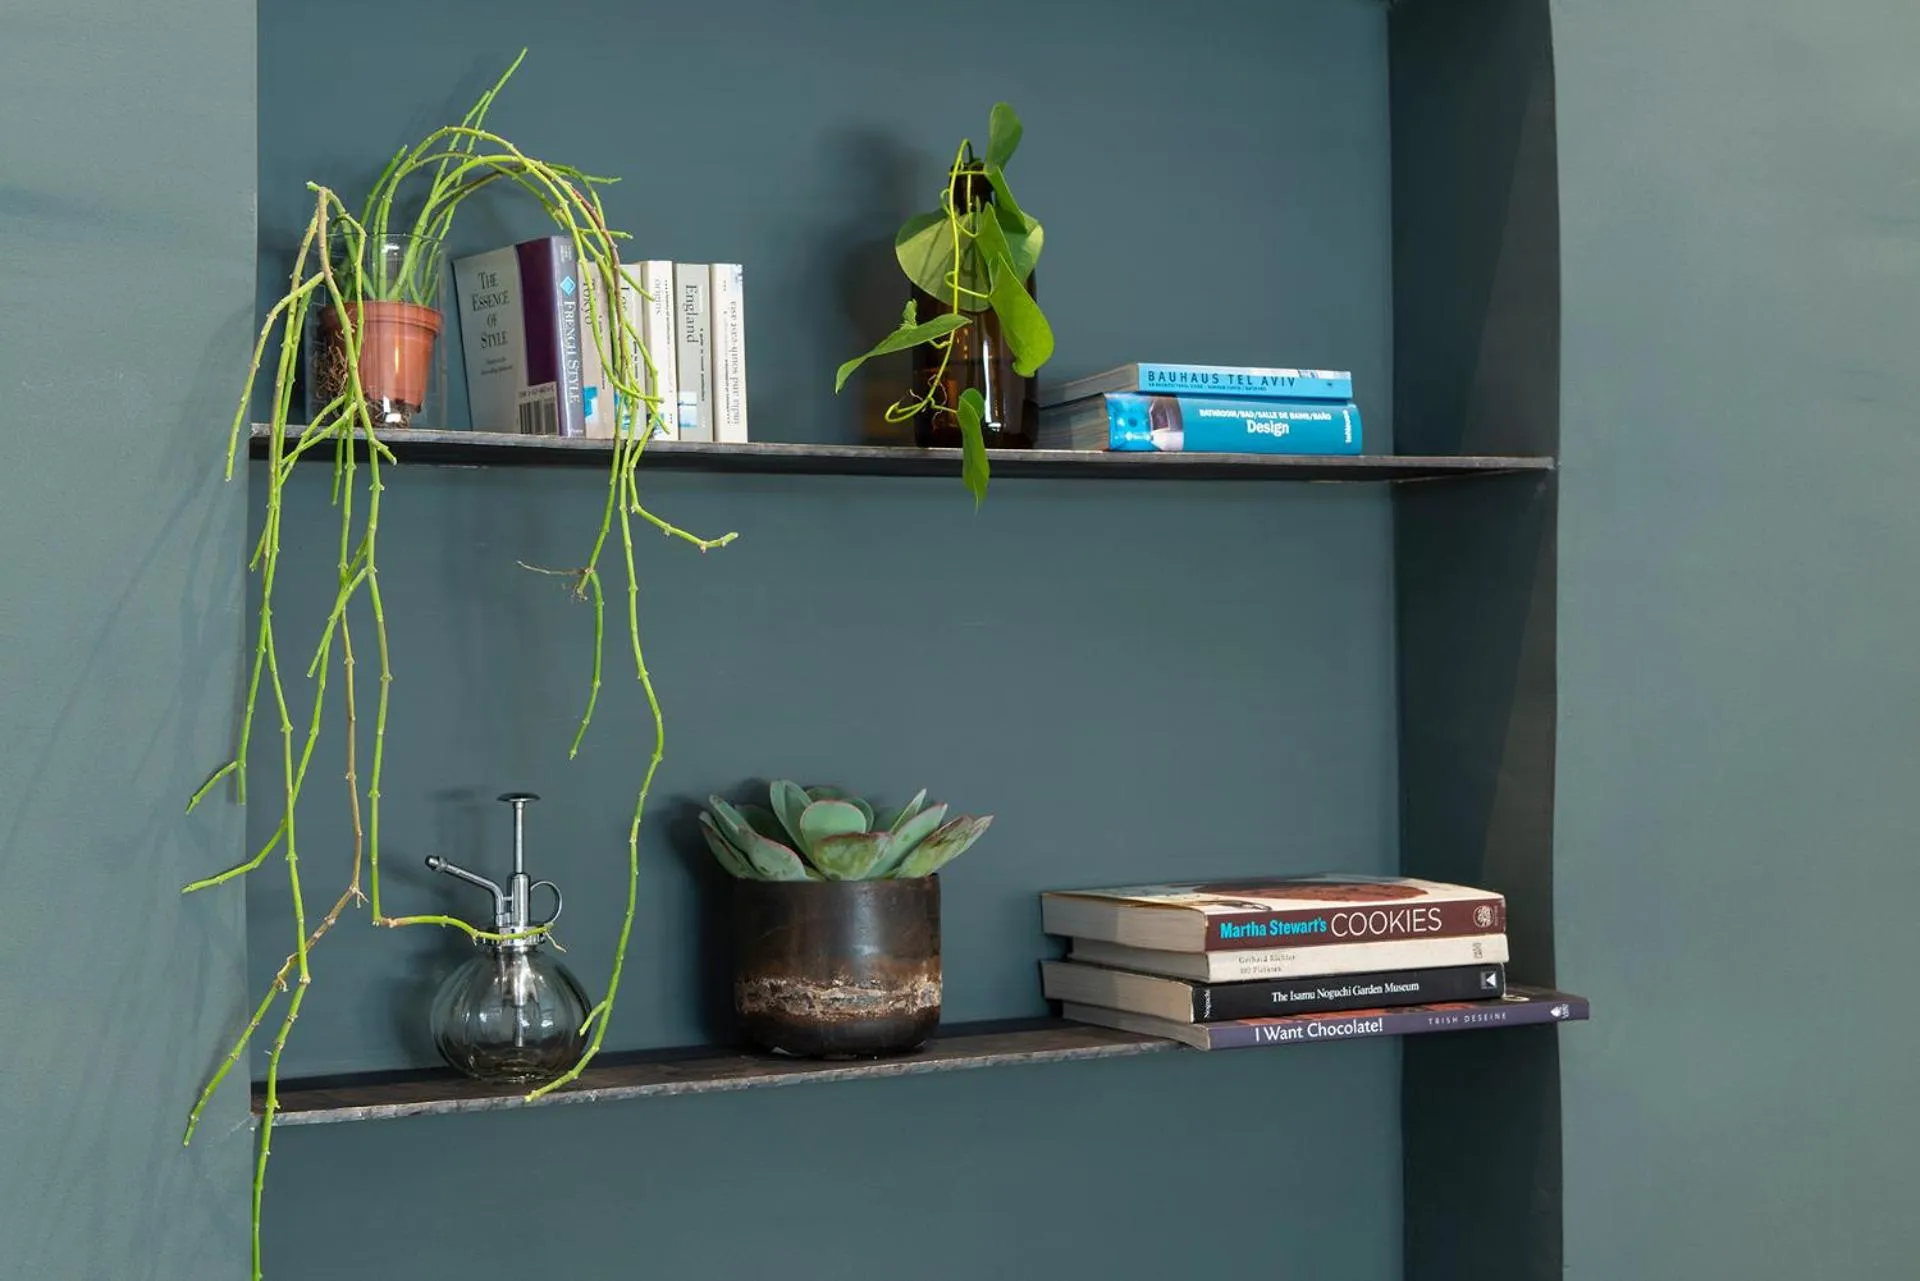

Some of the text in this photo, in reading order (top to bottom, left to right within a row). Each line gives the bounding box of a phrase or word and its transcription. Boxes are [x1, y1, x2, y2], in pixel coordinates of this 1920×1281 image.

[478, 271, 498, 290] THE
[471, 290, 510, 312] ESSENCE
[486, 313, 498, 329] OF
[684, 283, 700, 344] England
[480, 330, 509, 350] STYLE
[563, 300, 581, 404] FRENCH STYLE
[1147, 370, 1220, 386] BAUHAUS
[1228, 373, 1253, 386] TEL
[1260, 375, 1296, 388] AVIV
[1247, 420, 1290, 437] Design
[1220, 907, 1443, 939] Martha Stewart's COOKIES
[1272, 981, 1420, 1002] The Isamu Noguchi Garden Museum
[1428, 1012, 1507, 1025] TRISH DESEINE
[1255, 1018, 1383, 1042] I Want Chocolate!
